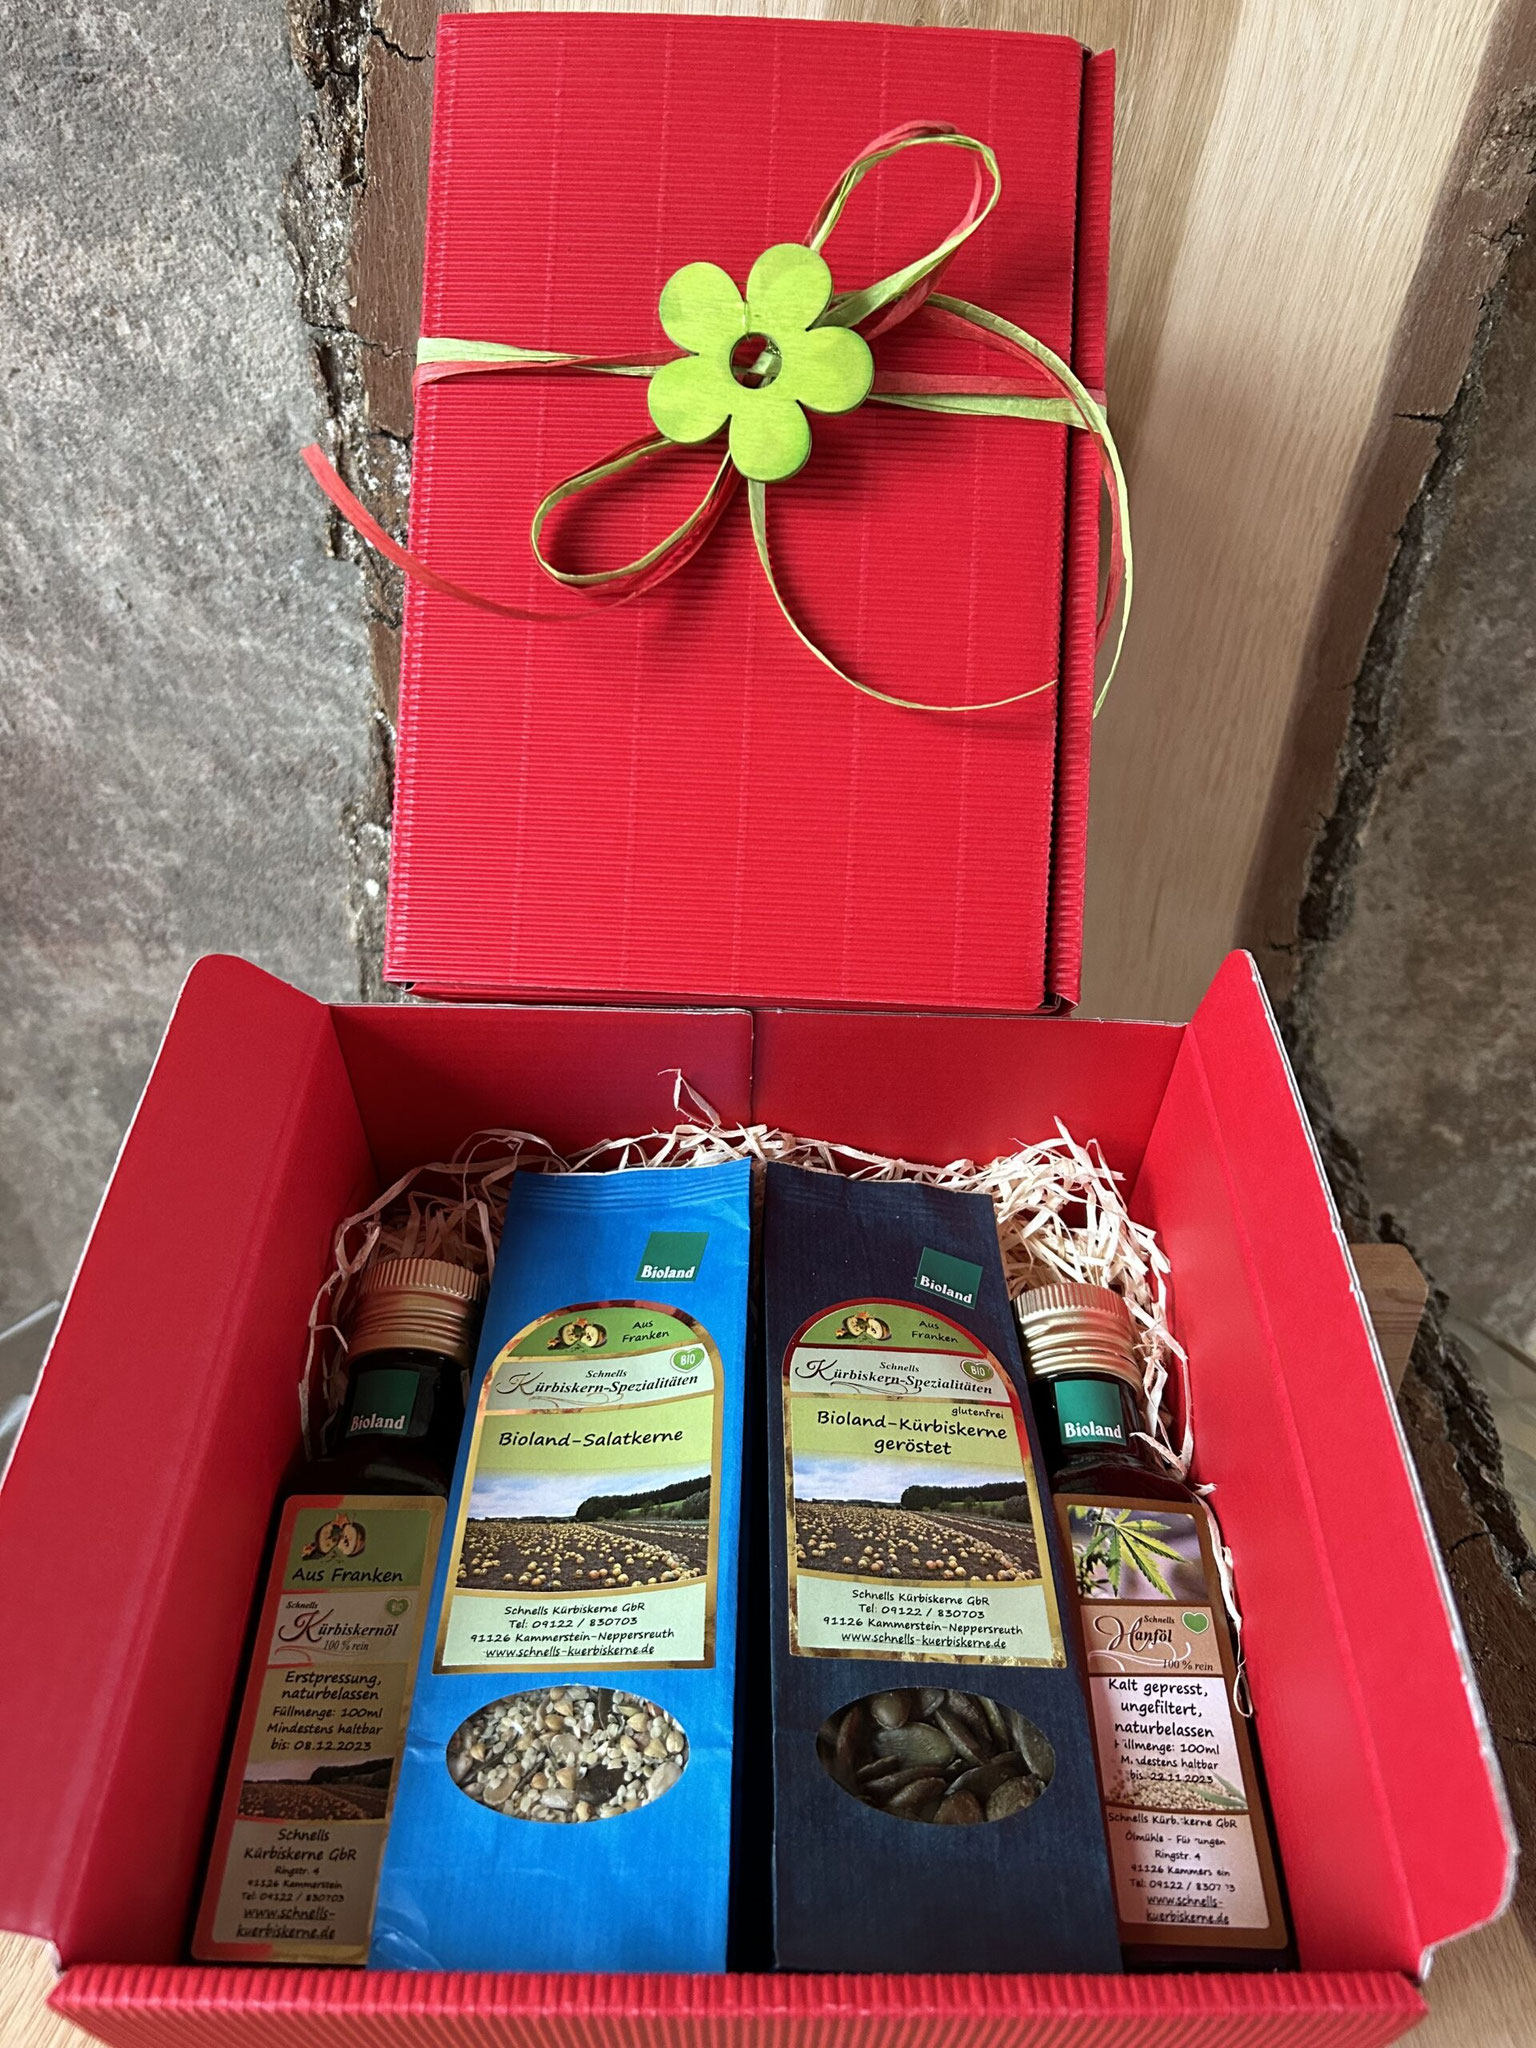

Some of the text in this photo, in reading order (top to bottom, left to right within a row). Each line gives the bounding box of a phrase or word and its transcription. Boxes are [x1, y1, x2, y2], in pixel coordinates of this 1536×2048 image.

[641, 1265, 695, 1279] Bioland
[920, 1275, 972, 1304] Bioland
[632, 1320, 653, 1329] Aus
[919, 1321, 939, 1329] Aus
[622, 1330, 669, 1343] Franken
[912, 1331, 958, 1343] Franken
[680, 1352, 695, 1365] BIO
[586, 1370, 627, 1378] Schnells
[879, 1361, 920, 1373] Schnells
[971, 1366, 985, 1377] BIO
[495, 1372, 698, 1395] Kürbiskern-Spezialitäten
[795, 1359, 992, 1395] Kürbiskern-Spezialitäten
[952, 1407, 1004, 1419] glutenfrei
[350, 1413, 405, 1431] Bioland
[817, 1411, 1007, 1439] Bioland-Kürbiskerne
[1064, 1421, 1122, 1438] Bioland
[499, 1429, 683, 1447] Bioland-Salatkerne
[874, 1437, 952, 1454] geröstet
[292, 1568, 403, 1582] Aus Franken
[286, 1601, 318, 1609] Schnells
[852, 1590, 990, 1606] Schnells Kürbiskerne GbR
[504, 1602, 646, 1616] Schnells Kürbiskerne GbR
[858, 1604, 878, 1614] Tel:
[882, 1606, 922, 1616] 09122
[938, 1609, 985, 1618] 830703
[278, 1609, 398, 1642] Kürbiskernöl
[508, 1618, 528, 1629] Tel:
[532, 1619, 574, 1629] 09122
[589, 1617, 638, 1626] 830703
[824, 1616, 1023, 1636] 91126 Kammerstein-Neppersreuth
[1144, 1615, 1175, 1624] Schnells
[470, 1630, 674, 1645] 91126 Kammerstein-Neppersreuth
[842, 1632, 1006, 1649] www.schnells-kuerbiskerne.de
[1093, 1615, 1172, 1652] Hanföl
[324, 1640, 339, 1650] 100
[352, 1642, 369, 1651] rein
[486, 1644, 654, 1658] www.schnells-kuerbiskerne.de
[1163, 1659, 1213, 1671] 100 % rein
[285, 1671, 381, 1688] Erstpressung,
[282, 1686, 379, 1700] naturbelassen
[1109, 1679, 1208, 1697] Kalt gepresst,
[272, 1706, 383, 1720] Füllmenge: 100ml
[1121, 1700, 1202, 1717] ungefiltert,
[267, 1723, 383, 1735] Mindestens haltbar
[1115, 1721, 1214, 1738] naturbelassen
[271, 1739, 371, 1750] bis: 08.12.2023
[1181, 1744, 1219, 1754] 100ml
[1121, 1755, 1218, 1770] Mdestens haltbar
[1108, 1813, 1237, 1828] Schnells Kürbkerne GbR
[277, 1829, 330, 1841] Schnells
[1125, 1831, 1164, 1843] Ölmühle
[1176, 1835, 1225, 1847] Füungen
[244, 1847, 356, 1862] Kürbiskerne GbR
[1155, 1849, 1200, 1861] Ringstr. 4
[313, 1867, 319, 1875] 4
[1131, 1864, 1230, 1876] 91126 Kammersein
[283, 1880, 342, 1889] Kammerstein
[1150, 1880, 1183, 1890] 09122
[1196, 1882, 1235, 1892] 83073
[1147, 1895, 1223, 1908] www.schnells-
[244, 1907, 335, 1920] www.schnells-
[1147, 1910, 1229, 1925] kuerbiskerne.de
[236, 1924, 335, 1939] kuerbiskerne.de
